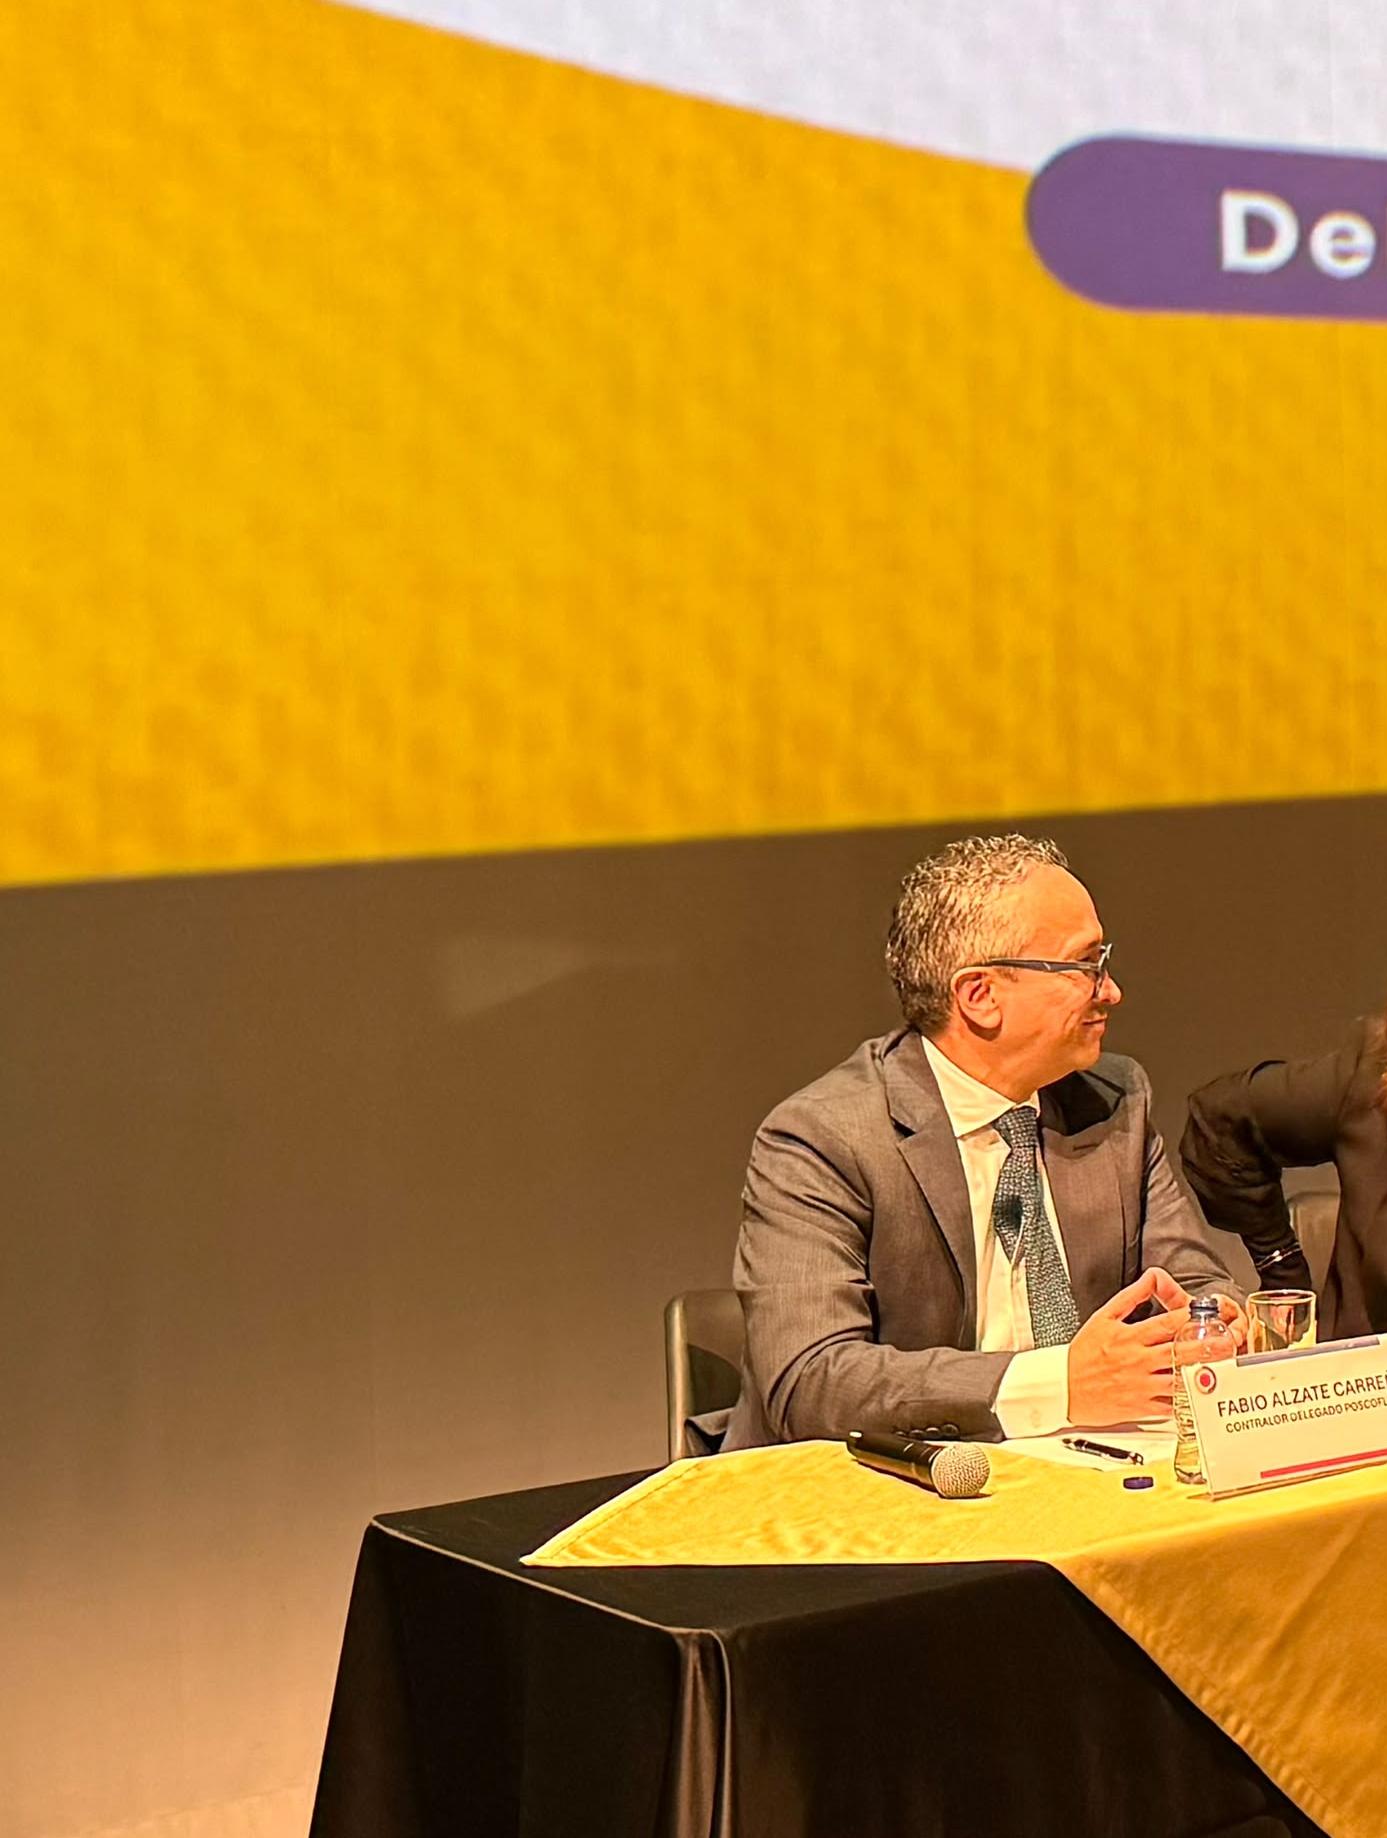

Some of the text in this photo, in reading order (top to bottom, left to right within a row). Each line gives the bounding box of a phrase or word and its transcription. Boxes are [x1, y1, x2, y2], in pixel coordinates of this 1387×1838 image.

[1217, 1394, 1268, 1418] FABIO
[1272, 1383, 1331, 1407] ALZATE
[1226, 1413, 1289, 1433] CONTRALOR
[1290, 1404, 1344, 1422] DELEGADO
